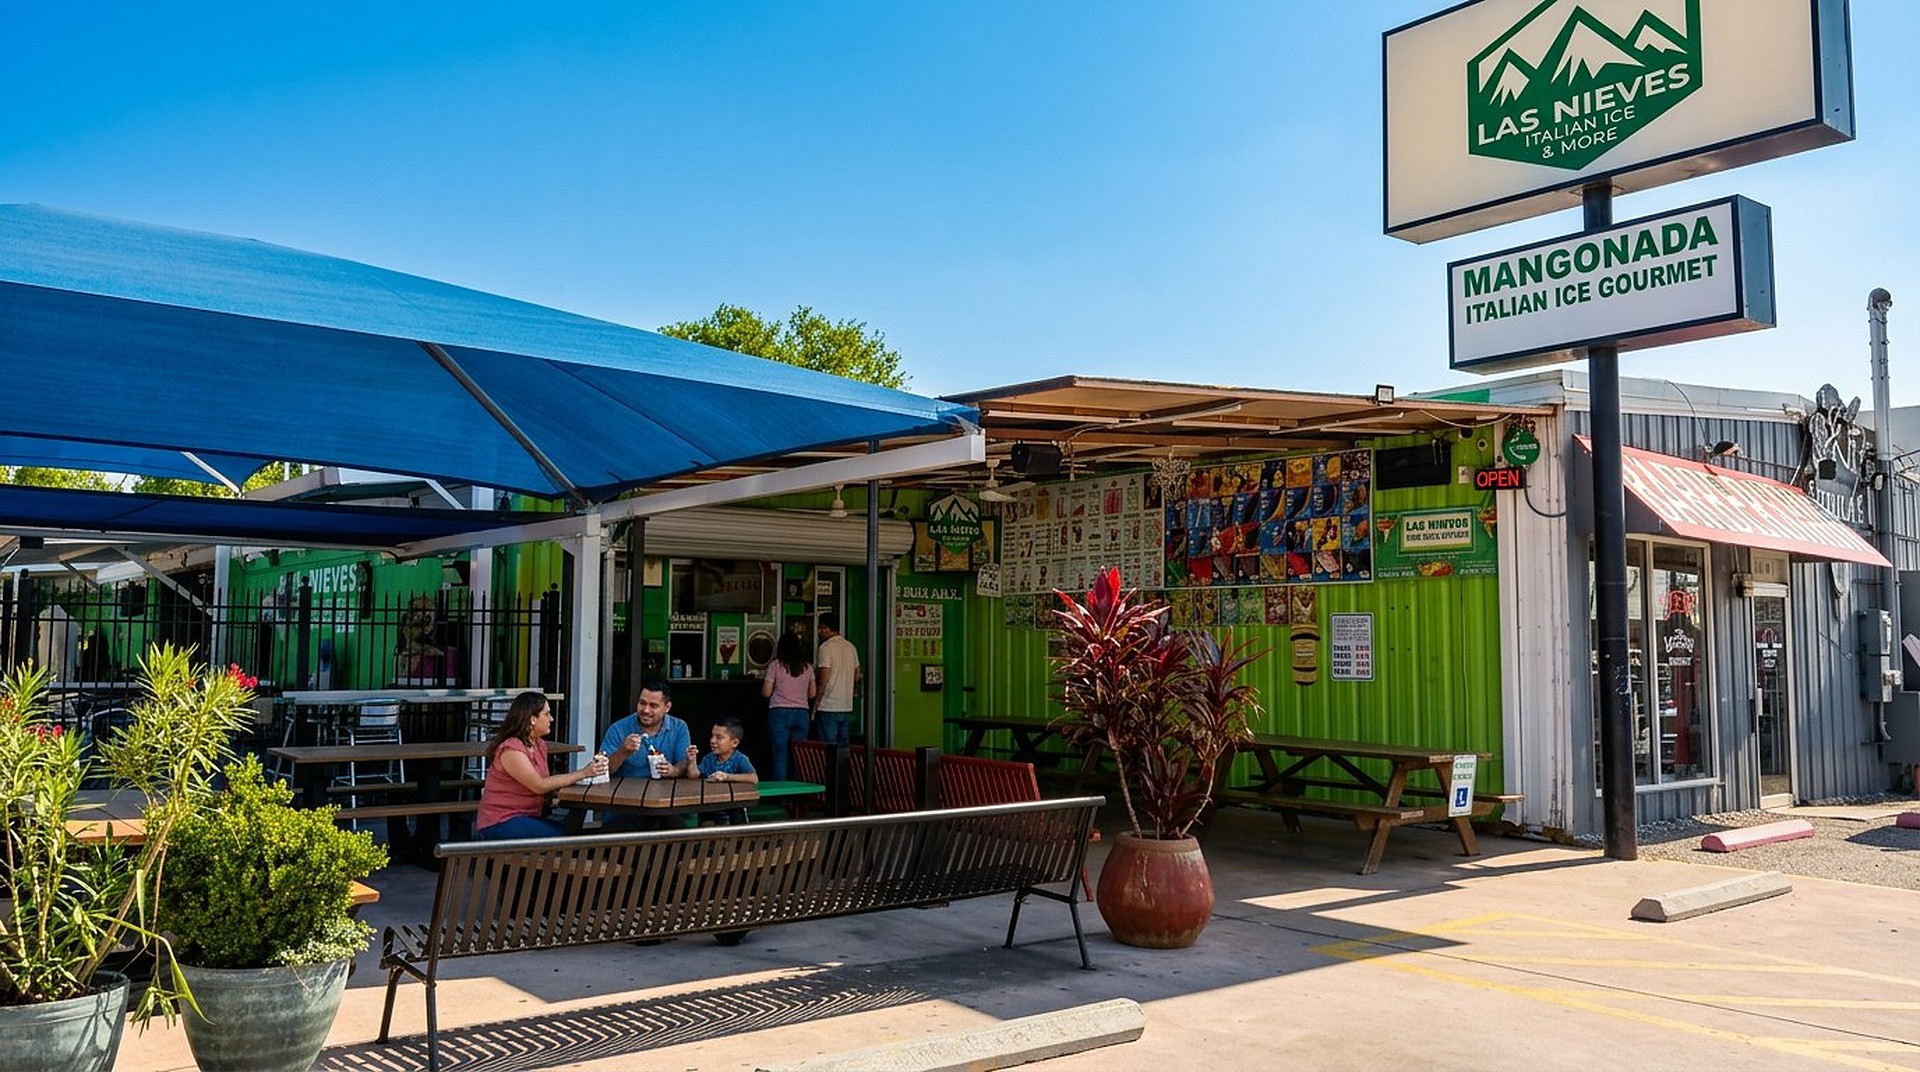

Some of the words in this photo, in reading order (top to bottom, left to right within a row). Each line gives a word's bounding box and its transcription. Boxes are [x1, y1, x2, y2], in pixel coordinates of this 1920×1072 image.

[1478, 109, 1540, 145] LAS
[1554, 63, 1691, 124] NIEVES
[1525, 116, 1597, 148] ITALIAN
[1605, 105, 1636, 126] ICE
[1542, 145, 1555, 159] &
[1561, 126, 1618, 155] MORE
[1463, 215, 1719, 298] MANGONADA
[1466, 290, 1547, 325] ITALIAN
[1555, 281, 1592, 308] ICE
[1598, 254, 1718, 299] GOURMET
[1476, 470, 1519, 487] OPEN
[309, 563, 358, 594] NIEVES
